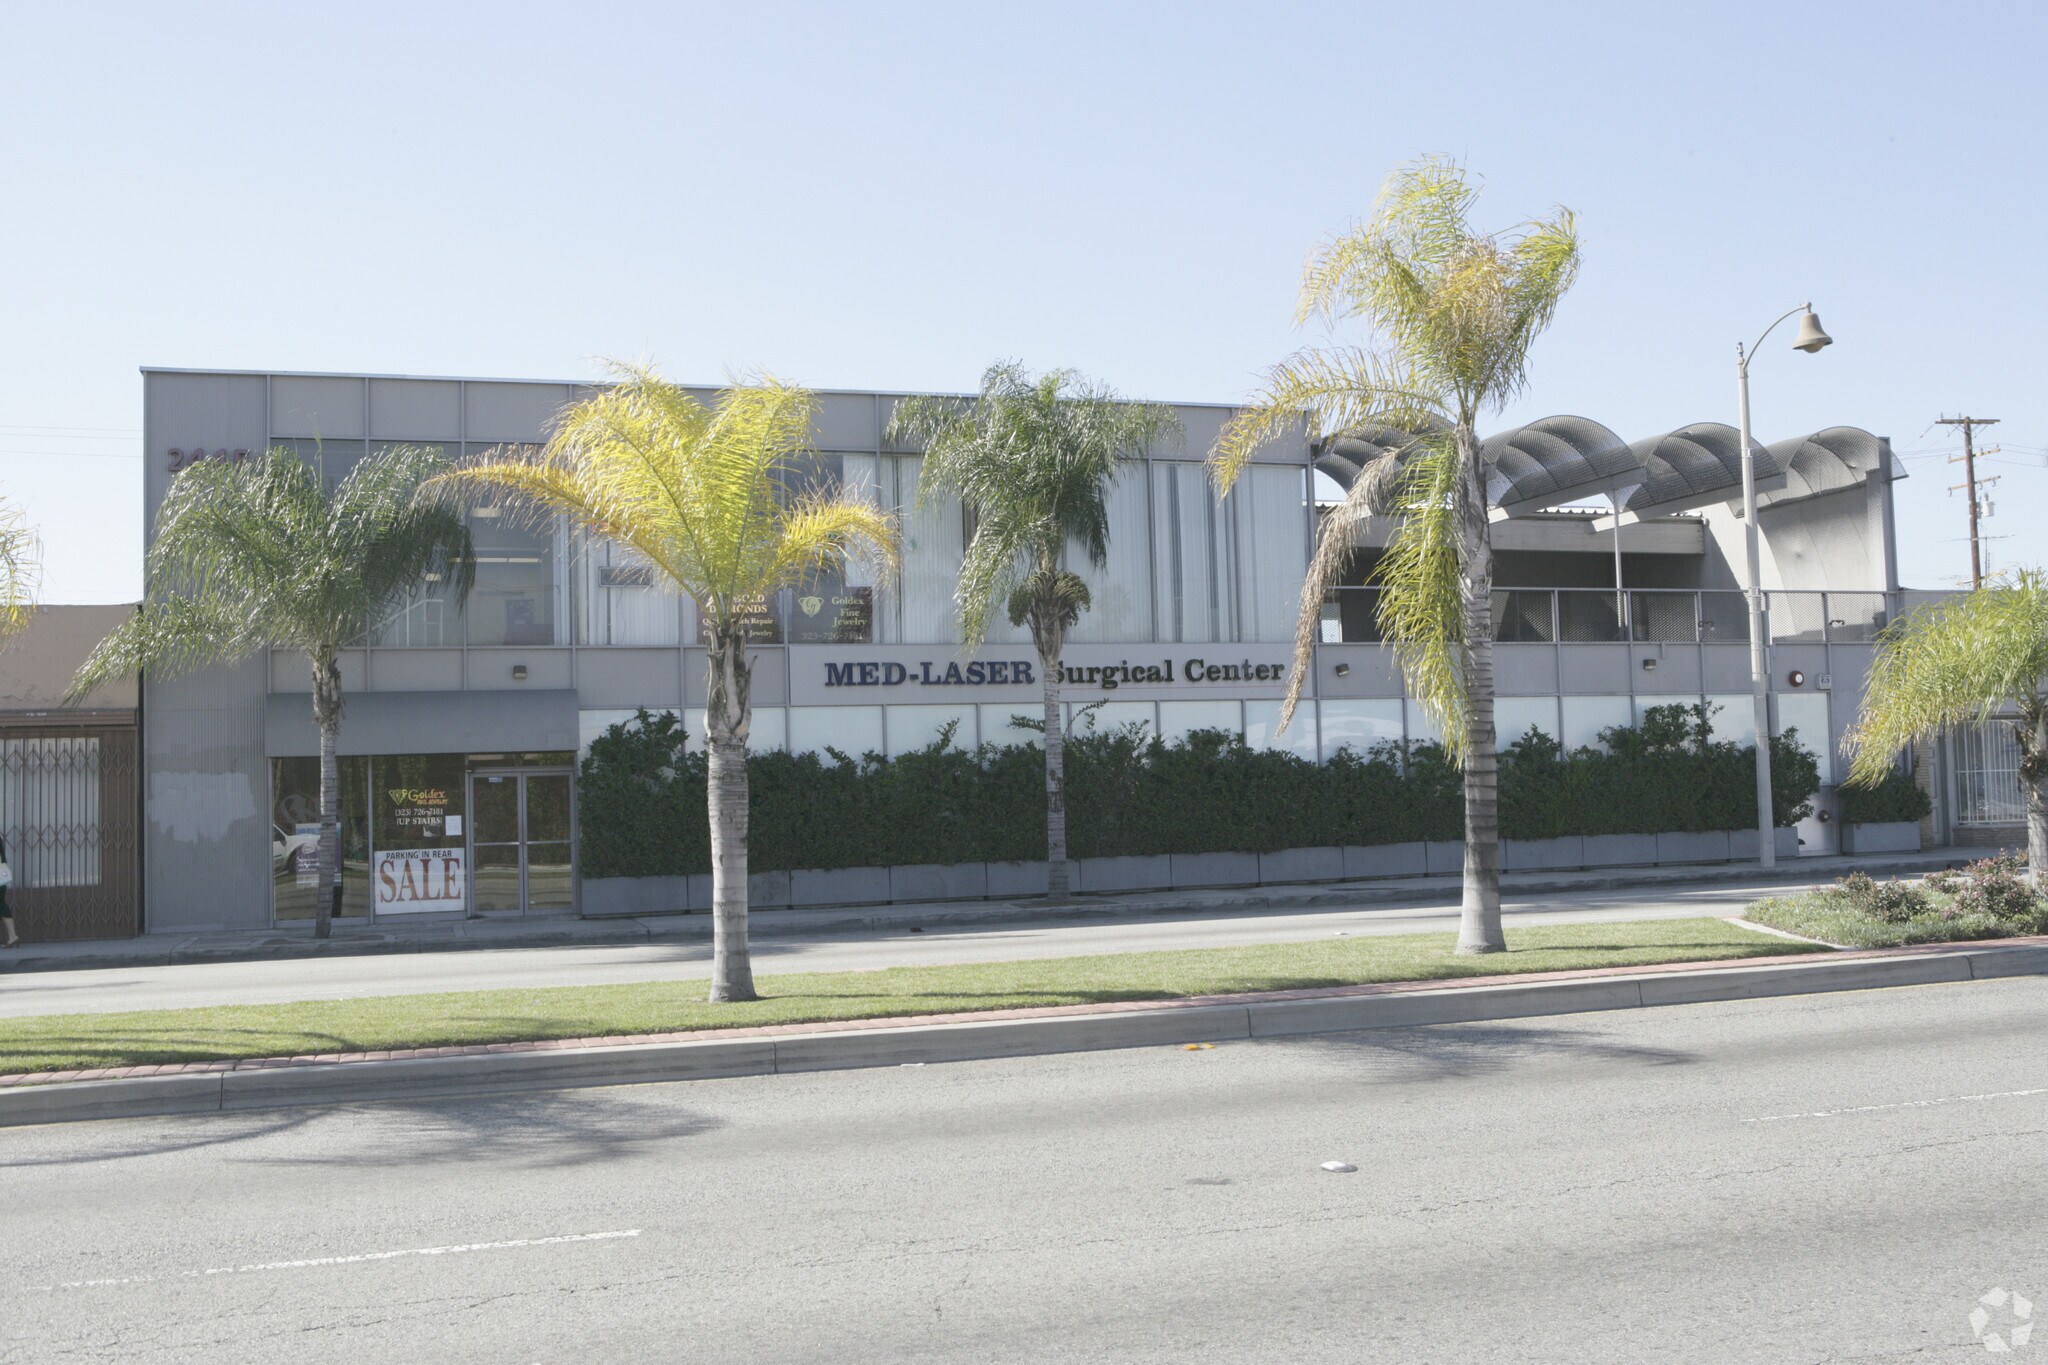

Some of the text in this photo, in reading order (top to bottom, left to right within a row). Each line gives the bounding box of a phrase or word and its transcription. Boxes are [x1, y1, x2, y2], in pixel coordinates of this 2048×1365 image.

[832, 596, 864, 605] Goldex
[841, 608, 860, 617] Fine
[751, 617, 773, 626] Repair
[832, 617, 867, 628] Jewelry
[749, 629, 773, 638] Jewelry
[824, 660, 1036, 687] MED-LASER
[1184, 658, 1285, 682] Center
[408, 788, 446, 801] Goldex
[395, 808, 444, 816] (323) 726-7181
[386, 849, 453, 860] PARKING IN REAR
[380, 858, 461, 903] SALE
